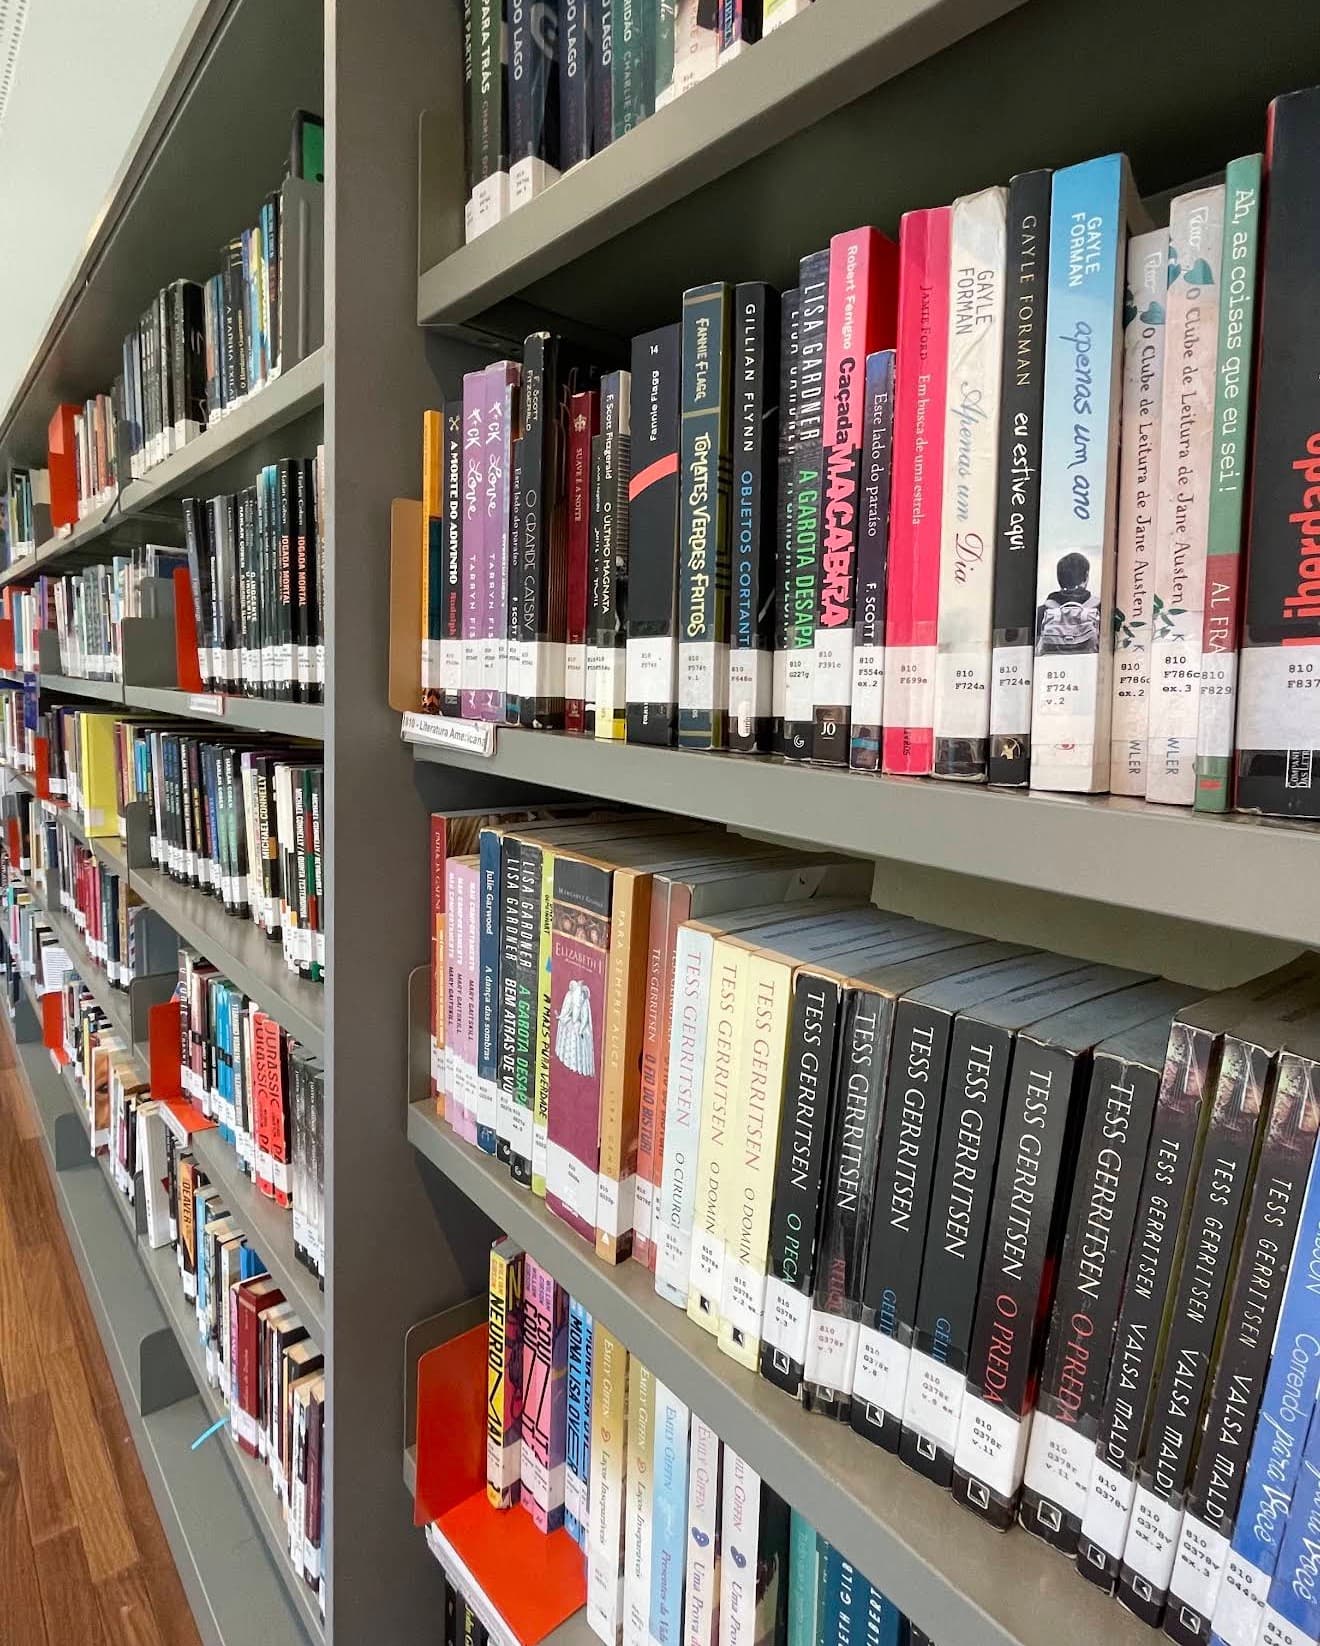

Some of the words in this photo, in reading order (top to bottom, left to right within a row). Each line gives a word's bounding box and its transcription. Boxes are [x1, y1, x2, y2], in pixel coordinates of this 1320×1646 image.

[513, 27, 523, 81] LAGO
[567, 24, 577, 78] LAGO
[602, 11, 612, 66] LAGO
[1231, 188, 1256, 225] Ah,
[846, 245, 859, 291] Robert
[1019, 214, 1038, 285] GAYLE
[1068, 211, 1087, 288] FORMAN
[1084, 216, 1104, 275] GAYLE
[1231, 231, 1248, 261] as
[803, 281, 826, 333] LISA
[955, 267, 975, 336] FORMAN
[975, 270, 995, 325] GAYLE
[1186, 288, 1200, 301] O
[1226, 266, 1251, 350] coisas
[695, 317, 711, 361] FANNIE
[743, 303, 756, 382] GILLIAN
[841, 294, 857, 350] Ferrigno
[1016, 294, 1035, 387] FORMAN
[1141, 327, 1156, 339] O
[1183, 306, 1201, 359] Clube
[649, 370, 660, 399] Flagg
[693, 360, 710, 403] FLAGG
[799, 342, 824, 441] GARDNER
[917, 374, 931, 395] Em
[1059, 320, 1093, 416] apenas
[1139, 345, 1157, 393] Clube
[1181, 366, 1200, 386] de
[1220, 356, 1241, 400] que
[649, 400, 660, 442] Fannie
[743, 392, 755, 452] FLYNN
[833, 356, 856, 446] Caçada
[873, 393, 888, 425] Este
[915, 397, 930, 435] busca
[1014, 411, 1030, 436] eu
[1139, 398, 1156, 418] de
[1177, 389, 1198, 460] Leitura
[1222, 407, 1238, 436] eu
[870, 427, 886, 459] lado
[912, 449, 925, 475] uma
[1067, 422, 1091, 470] um
[1136, 421, 1154, 484] Leitura
[689, 432, 712, 506] TOMATES
[871, 464, 885, 482] do
[1009, 442, 1036, 507] estive
[1177, 464, 1194, 486] de
[1218, 441, 1241, 493] sei!
[866, 486, 883, 537] paraíso
[911, 478, 926, 525] estrela
[1072, 474, 1091, 521] ano
[1136, 489, 1152, 508] de
[1174, 492, 1194, 535] Jane
[687, 505, 712, 572] VERDES
[820, 440, 858, 628] MACABRA
[1004, 512, 1025, 552] aqui
[1135, 514, 1152, 554] Jane
[282, 570, 290, 606] MORTAL
[298, 571, 306, 607] MORTAL
[865, 582, 877, 593] F.
[1132, 560, 1151, 618] Austen
[1171, 541, 1191, 605] Austen
[1210, 581, 1232, 608] AL
[687, 573, 710, 637] FRITOS
[863, 595, 877, 638] SCOTT
[956, 669, 974, 678] 810
[999, 665, 1018, 674] 810
[1046, 670, 1066, 680] 810
[1120, 663, 1140, 672] 810
[1163, 669, 1201, 680] F786c
[1164, 655, 1187, 665] 810
[1201, 670, 1225, 680] 810
[1288, 663, 1314, 674] 810
[1046, 683, 1080, 693] F724a
[1118, 688, 1145, 698] ex.2
[1162, 684, 1192, 694] ex.3
[1287, 679, 1320, 689] F837
[419, 719, 449, 737] Literatura
[820, 721, 837, 736] JO
[257, 775, 268, 820] CONNELLY
[261, 820, 270, 860] MICHAEL
[485, 869, 495, 892] Julie
[506, 857, 520, 890] LISA
[522, 860, 536, 893] LISA
[485, 893, 495, 936] Garwood
[505, 897, 519, 962] GARDNER
[519, 901, 534, 969] GARDNER
[485, 964, 493, 973] A
[652, 947, 661, 975] TESS
[684, 951, 701, 1000] TESS
[484, 975, 494, 1004] dança
[648, 976, 660, 1042] GERRITSEN
[718, 963, 738, 1014] TESS
[755, 979, 775, 1033] TESS
[484, 1005, 493, 1022] das
[803, 991, 826, 1047] TESS
[483, 1023, 493, 1062] sombras
[851, 1012, 876, 1067] TESS
[907, 1025, 934, 1083] TESS
[265, 1028, 280, 1110] JURASSIC
[676, 1004, 697, 1128] GERRITSEN
[711, 1019, 733, 1146] GERRITSEN
[964, 1043, 993, 1104] TESS
[745, 1039, 771, 1173] GERRITSEN
[790, 1052, 820, 1192] GERRITSEN
[1022, 1069, 1053, 1129] TESS
[1102, 1082, 1136, 1144] TESS
[836, 1073, 870, 1213] GERRITSEN
[889, 1087, 926, 1233] GERRITSEN
[1155, 1137, 1180, 1185] TESS
[181, 1180, 191, 1224] DEAVER
[942, 1108, 984, 1261] GERRITSEN
[1209, 1156, 1237, 1207] TESS
[1262, 1177, 1292, 1228] TESS
[786, 1212, 802, 1232] O
[1000, 1132, 1042, 1281] GERRITSEN
[1076, 1147, 1122, 1300] GERRITSEN
[1134, 1194, 1169, 1300] GERRITSEN
[1185, 1215, 1224, 1324] GERRITSEN
[995, 1293, 1019, 1319] O
[1237, 1237, 1279, 1350] GERRITSEN
[570, 1313, 583, 1364] MONA
[983, 1321, 1017, 1402] PREDA
[1119, 1322, 1148, 1391] VALSA
[569, 1364, 581, 1402] LISA
[1167, 1347, 1200, 1418] VALSA
[1106, 1396, 1134, 1470] MALDI
[1218, 1373, 1253, 1447] VALSA
[697, 1424, 711, 1464] EMILY
[1153, 1424, 1184, 1500] MALDI
[695, 1467, 710, 1513] GIFFIN
[1097, 1474, 1118, 1492] 810
[1203, 1451, 1235, 1530] MALDI
[1139, 1504, 1161, 1523] 810
[1185, 1529, 1208, 1549] 810
[692, 1560, 705, 1593] Uma
[1229, 1562, 1253, 1585] 810
[690, 1595, 704, 1633] Prova
[1266, 1622, 1293, 1646] 810
